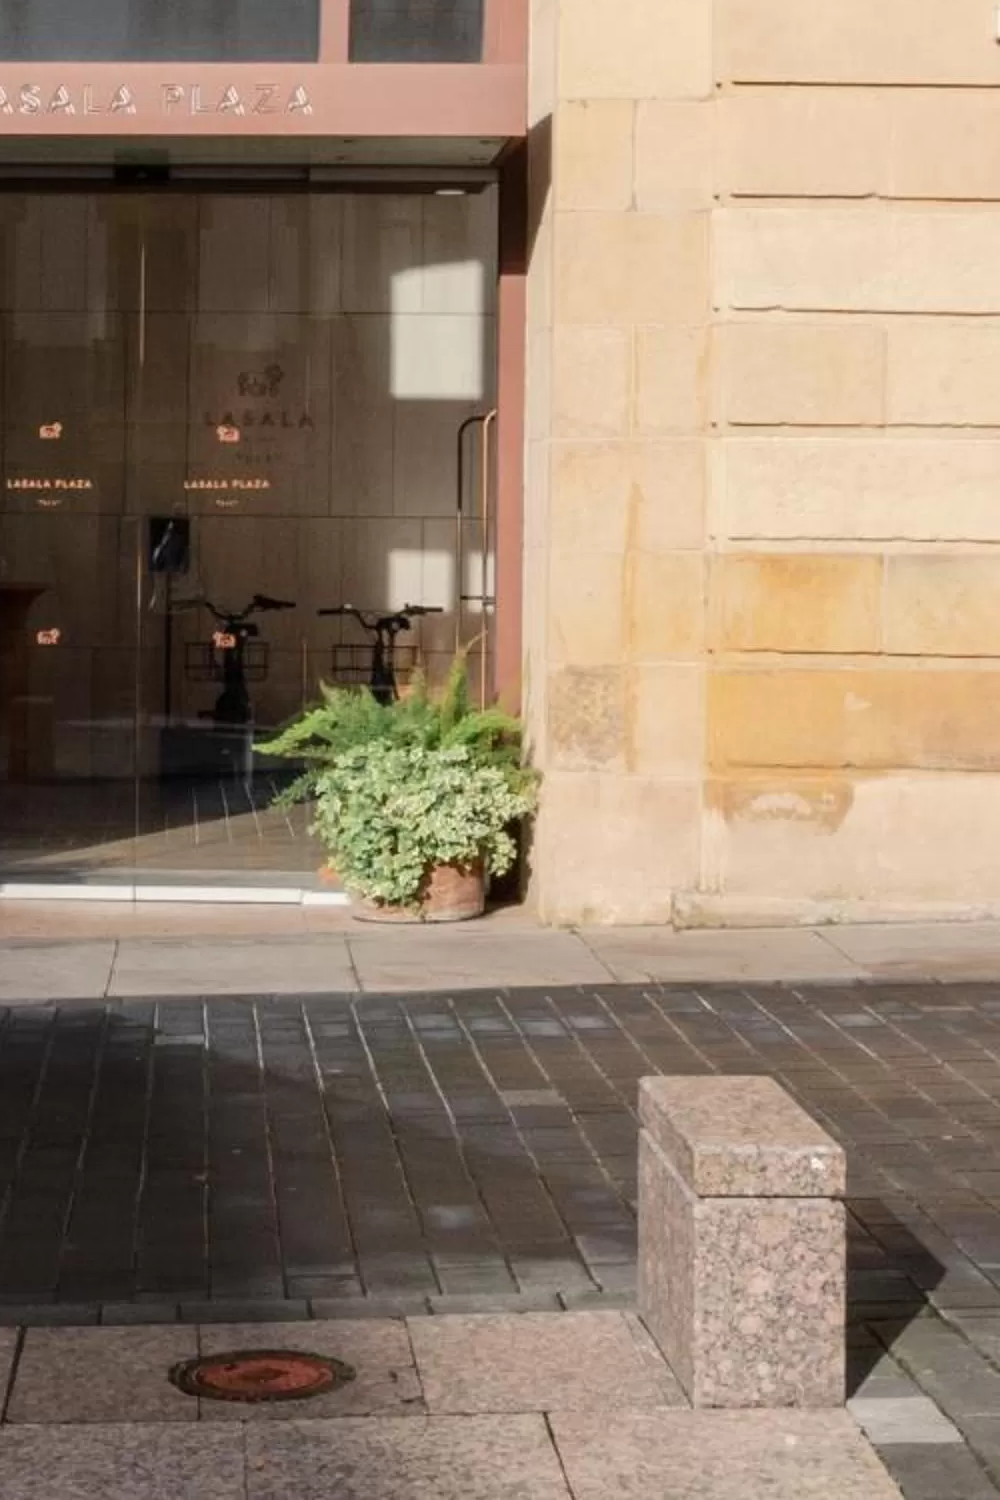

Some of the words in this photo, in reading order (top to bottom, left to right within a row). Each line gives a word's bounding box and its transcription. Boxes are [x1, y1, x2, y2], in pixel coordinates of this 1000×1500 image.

[160, 83, 313, 117] PLAZA
[204, 411, 314, 430] LASALA
[6, 479, 51, 489] LASALA
[55, 479, 92, 489] PLAZA
[183, 479, 228, 489] LASALA
[232, 479, 270, 489] PLAZA
